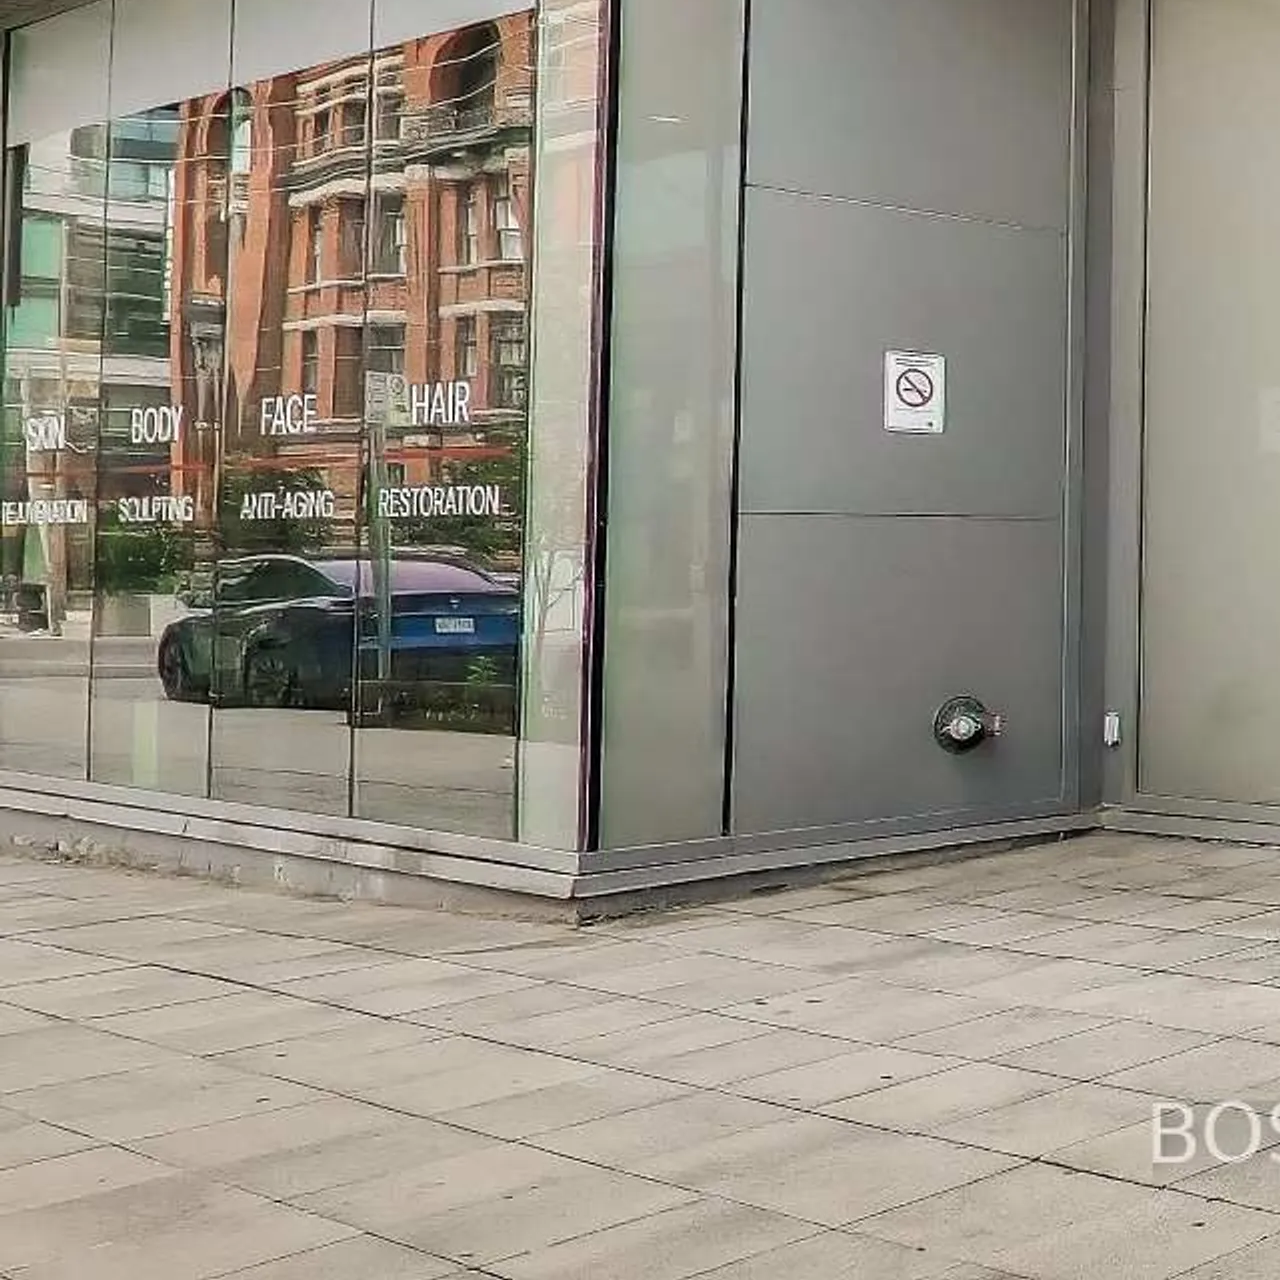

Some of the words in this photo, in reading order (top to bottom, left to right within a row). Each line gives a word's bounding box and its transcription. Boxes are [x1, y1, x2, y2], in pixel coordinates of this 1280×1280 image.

[260, 393, 317, 436] FACE
[411, 381, 470, 425] HAIR
[131, 405, 183, 444] BODY
[118, 495, 194, 522] SCULPTING
[240, 490, 334, 520] ANTI-AGING
[378, 484, 501, 518] RESTORATION
